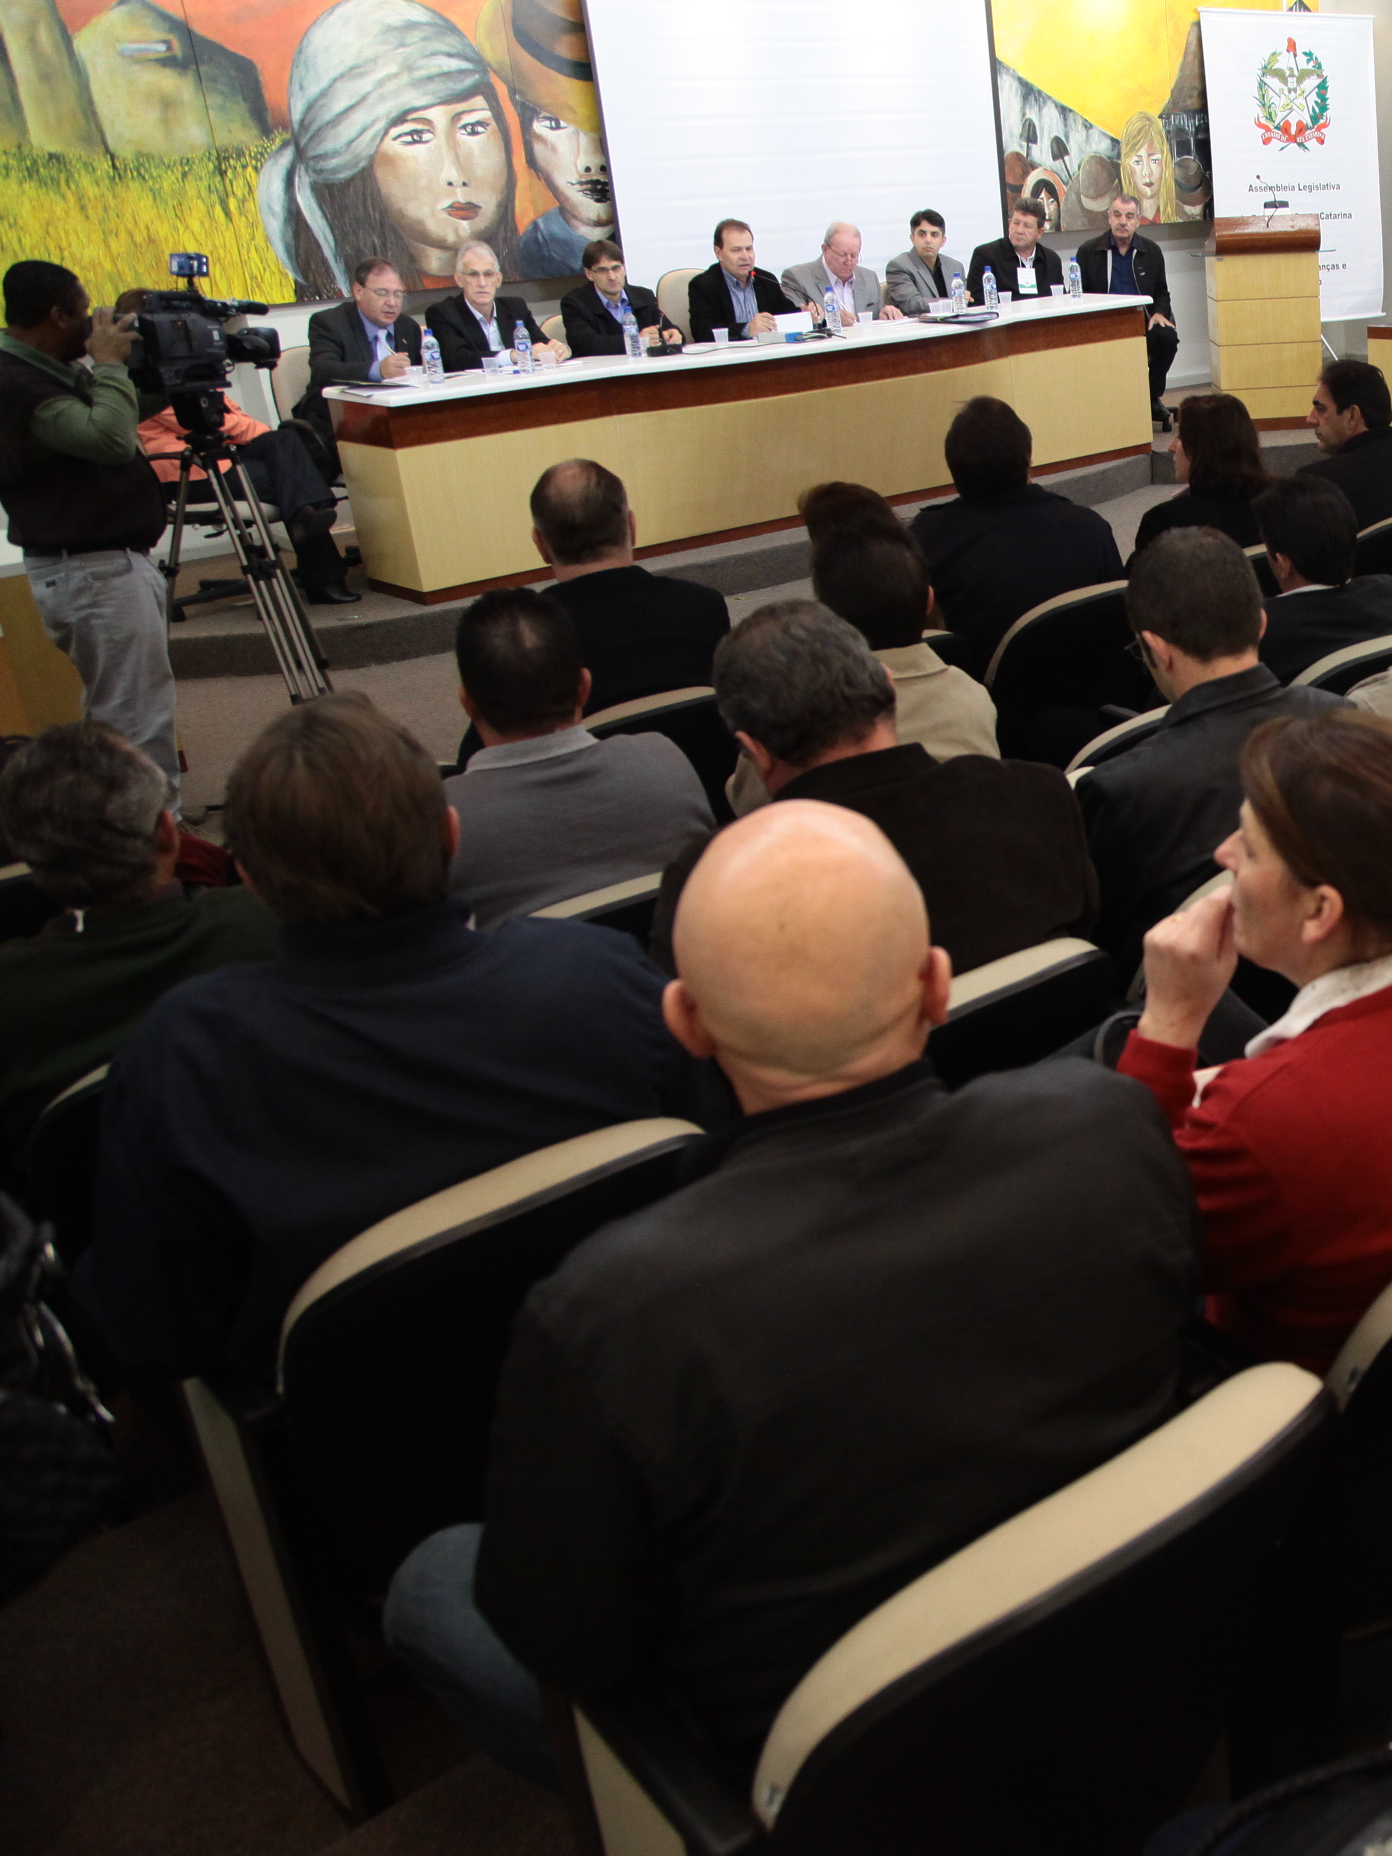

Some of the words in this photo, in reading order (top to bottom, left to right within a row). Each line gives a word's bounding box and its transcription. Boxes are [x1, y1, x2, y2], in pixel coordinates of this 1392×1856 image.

[1248, 183, 1295, 193] Assembleia
[1298, 182, 1341, 193] Legislativa
[1320, 211, 1352, 220] Catarina
